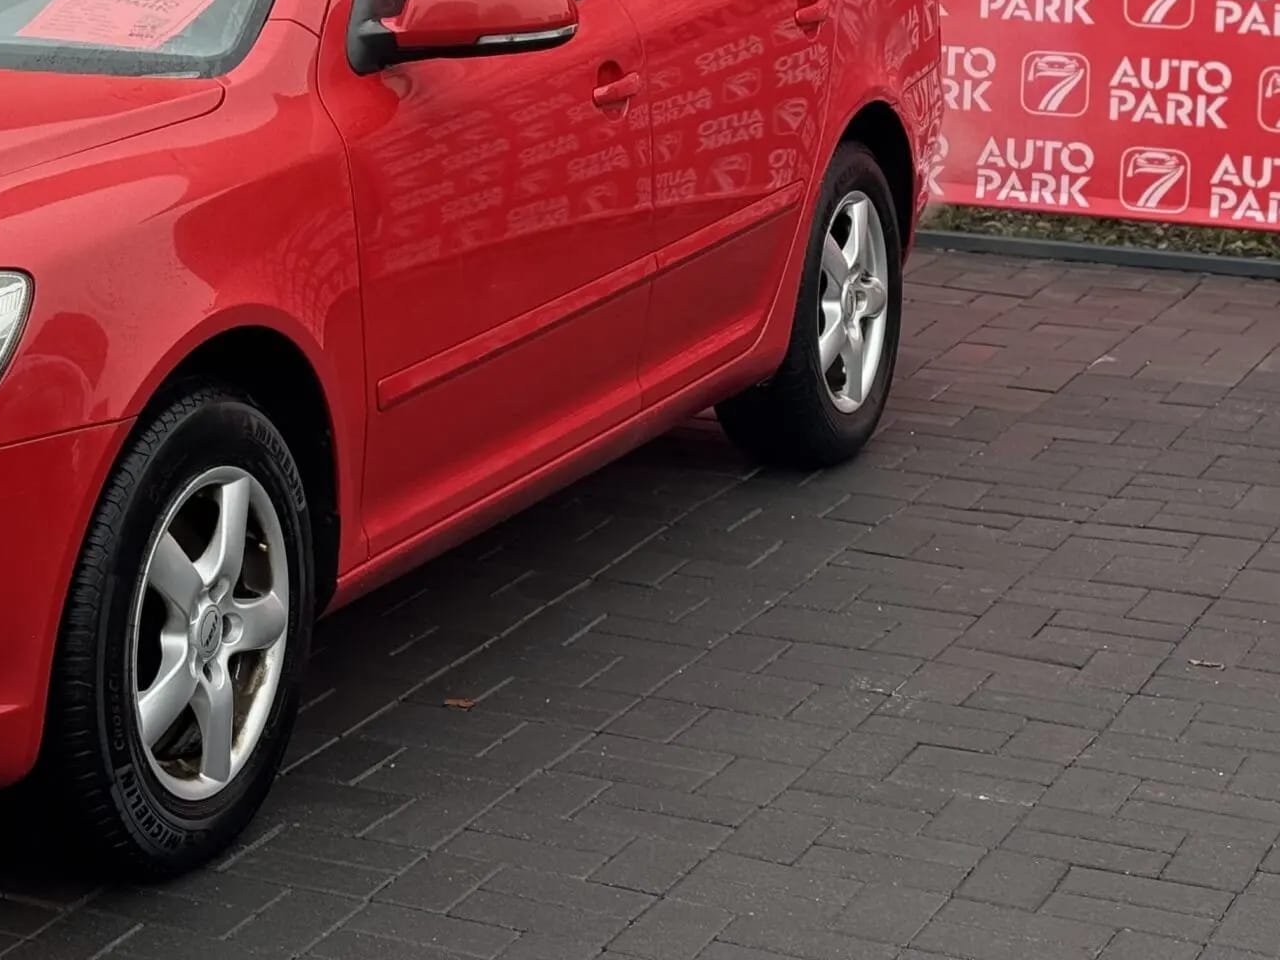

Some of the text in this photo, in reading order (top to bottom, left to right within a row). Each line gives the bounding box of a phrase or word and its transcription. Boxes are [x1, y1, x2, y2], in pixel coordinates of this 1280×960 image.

[1109, 56, 1232, 94] AUTO
[1109, 89, 1228, 129] PARK
[977, 138, 1094, 173] AUTO
[975, 171, 1090, 208] PARK
[254, 421, 306, 508] MICHELIN
[117, 767, 185, 852] MICHELIN
